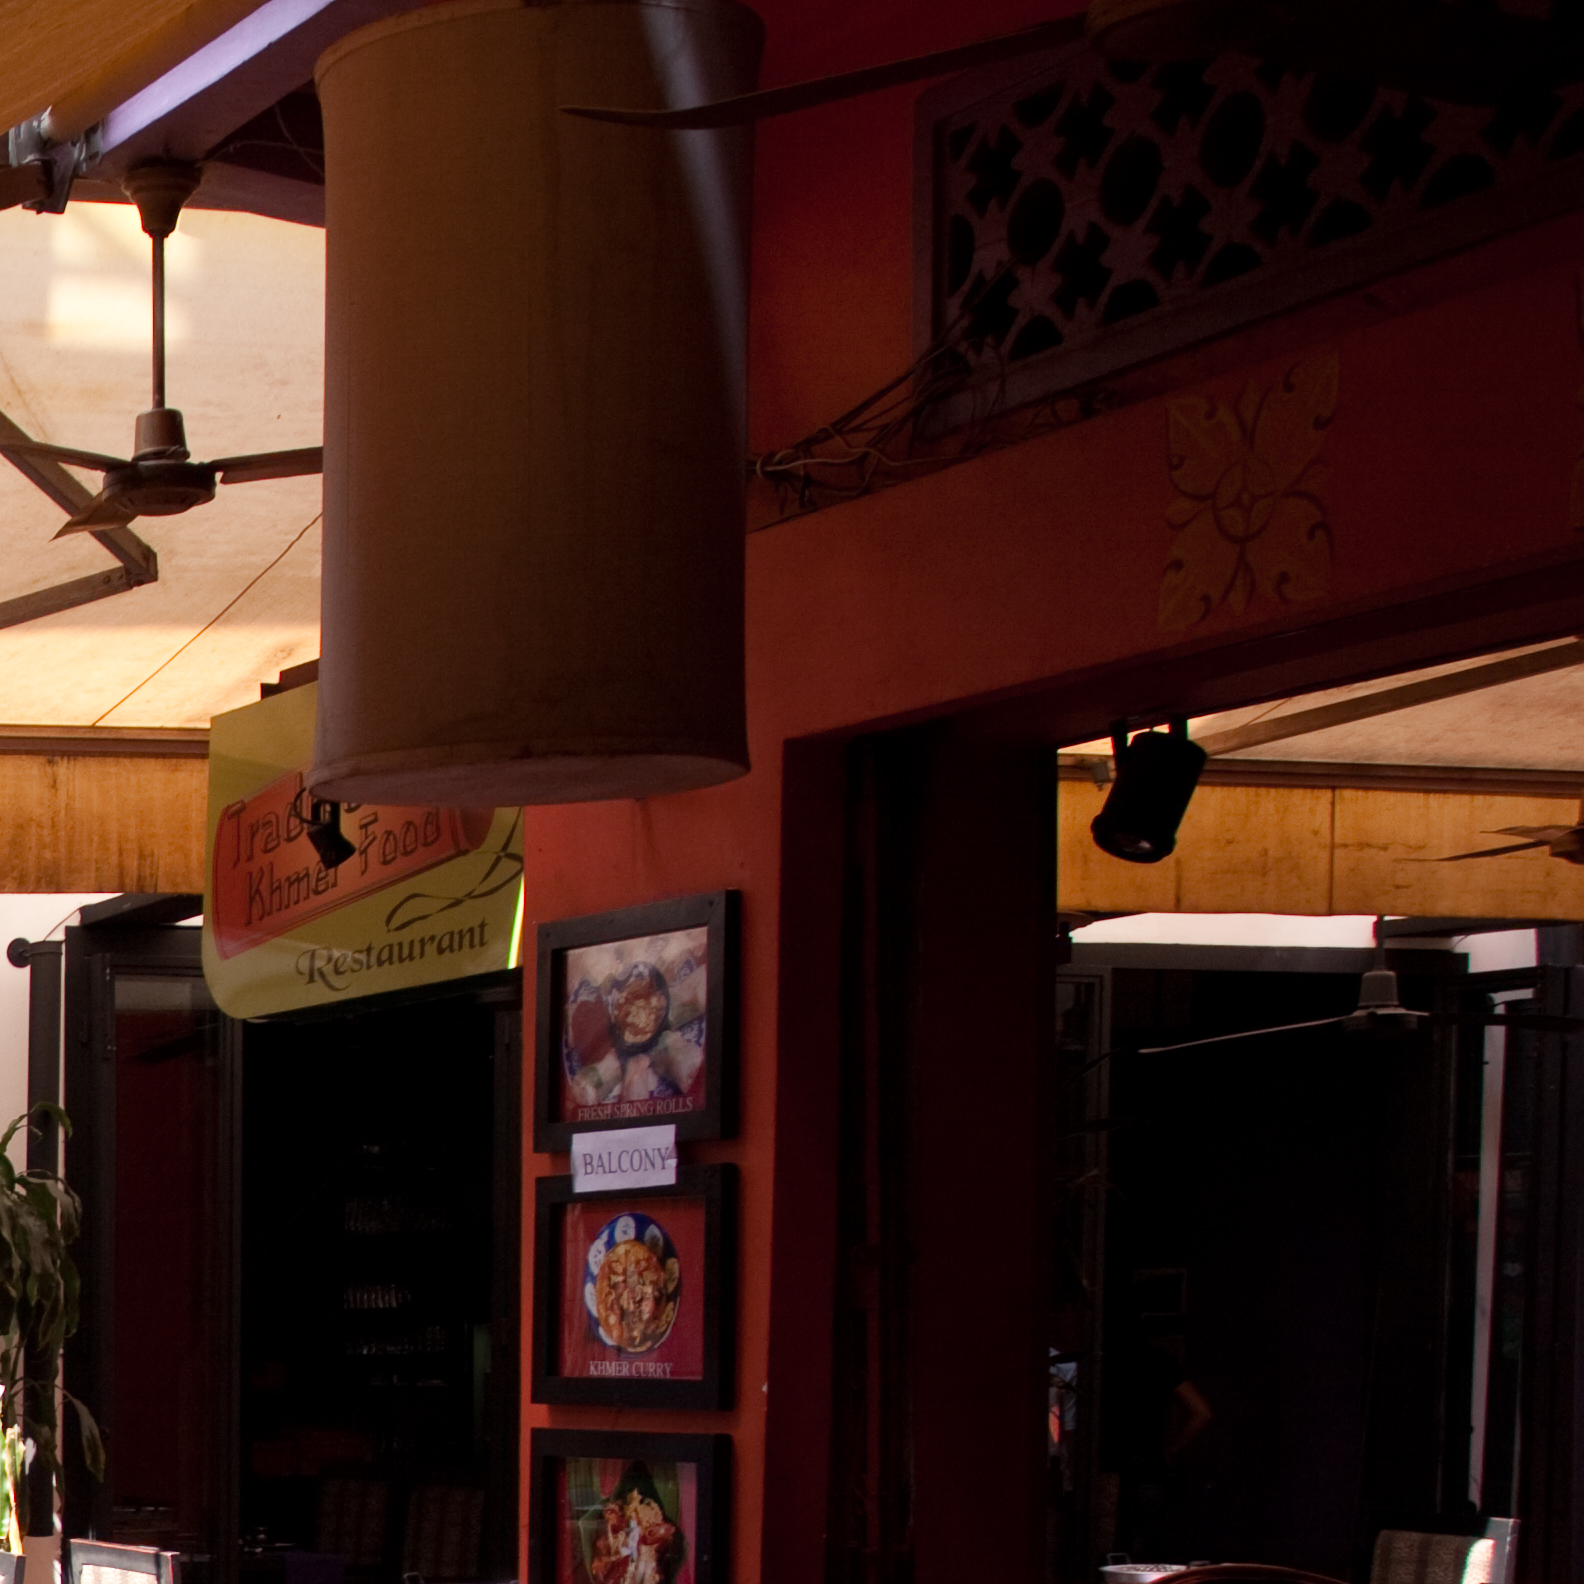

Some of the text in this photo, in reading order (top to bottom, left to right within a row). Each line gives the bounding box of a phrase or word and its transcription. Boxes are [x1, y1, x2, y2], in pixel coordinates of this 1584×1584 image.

[294, 917, 490, 992] Restaurant
[577, 1096, 693, 1122] FRESH SPRING ROLLS
[582, 1146, 670, 1176] BALCONY
[588, 1360, 672, 1378] KHMER CURRY
